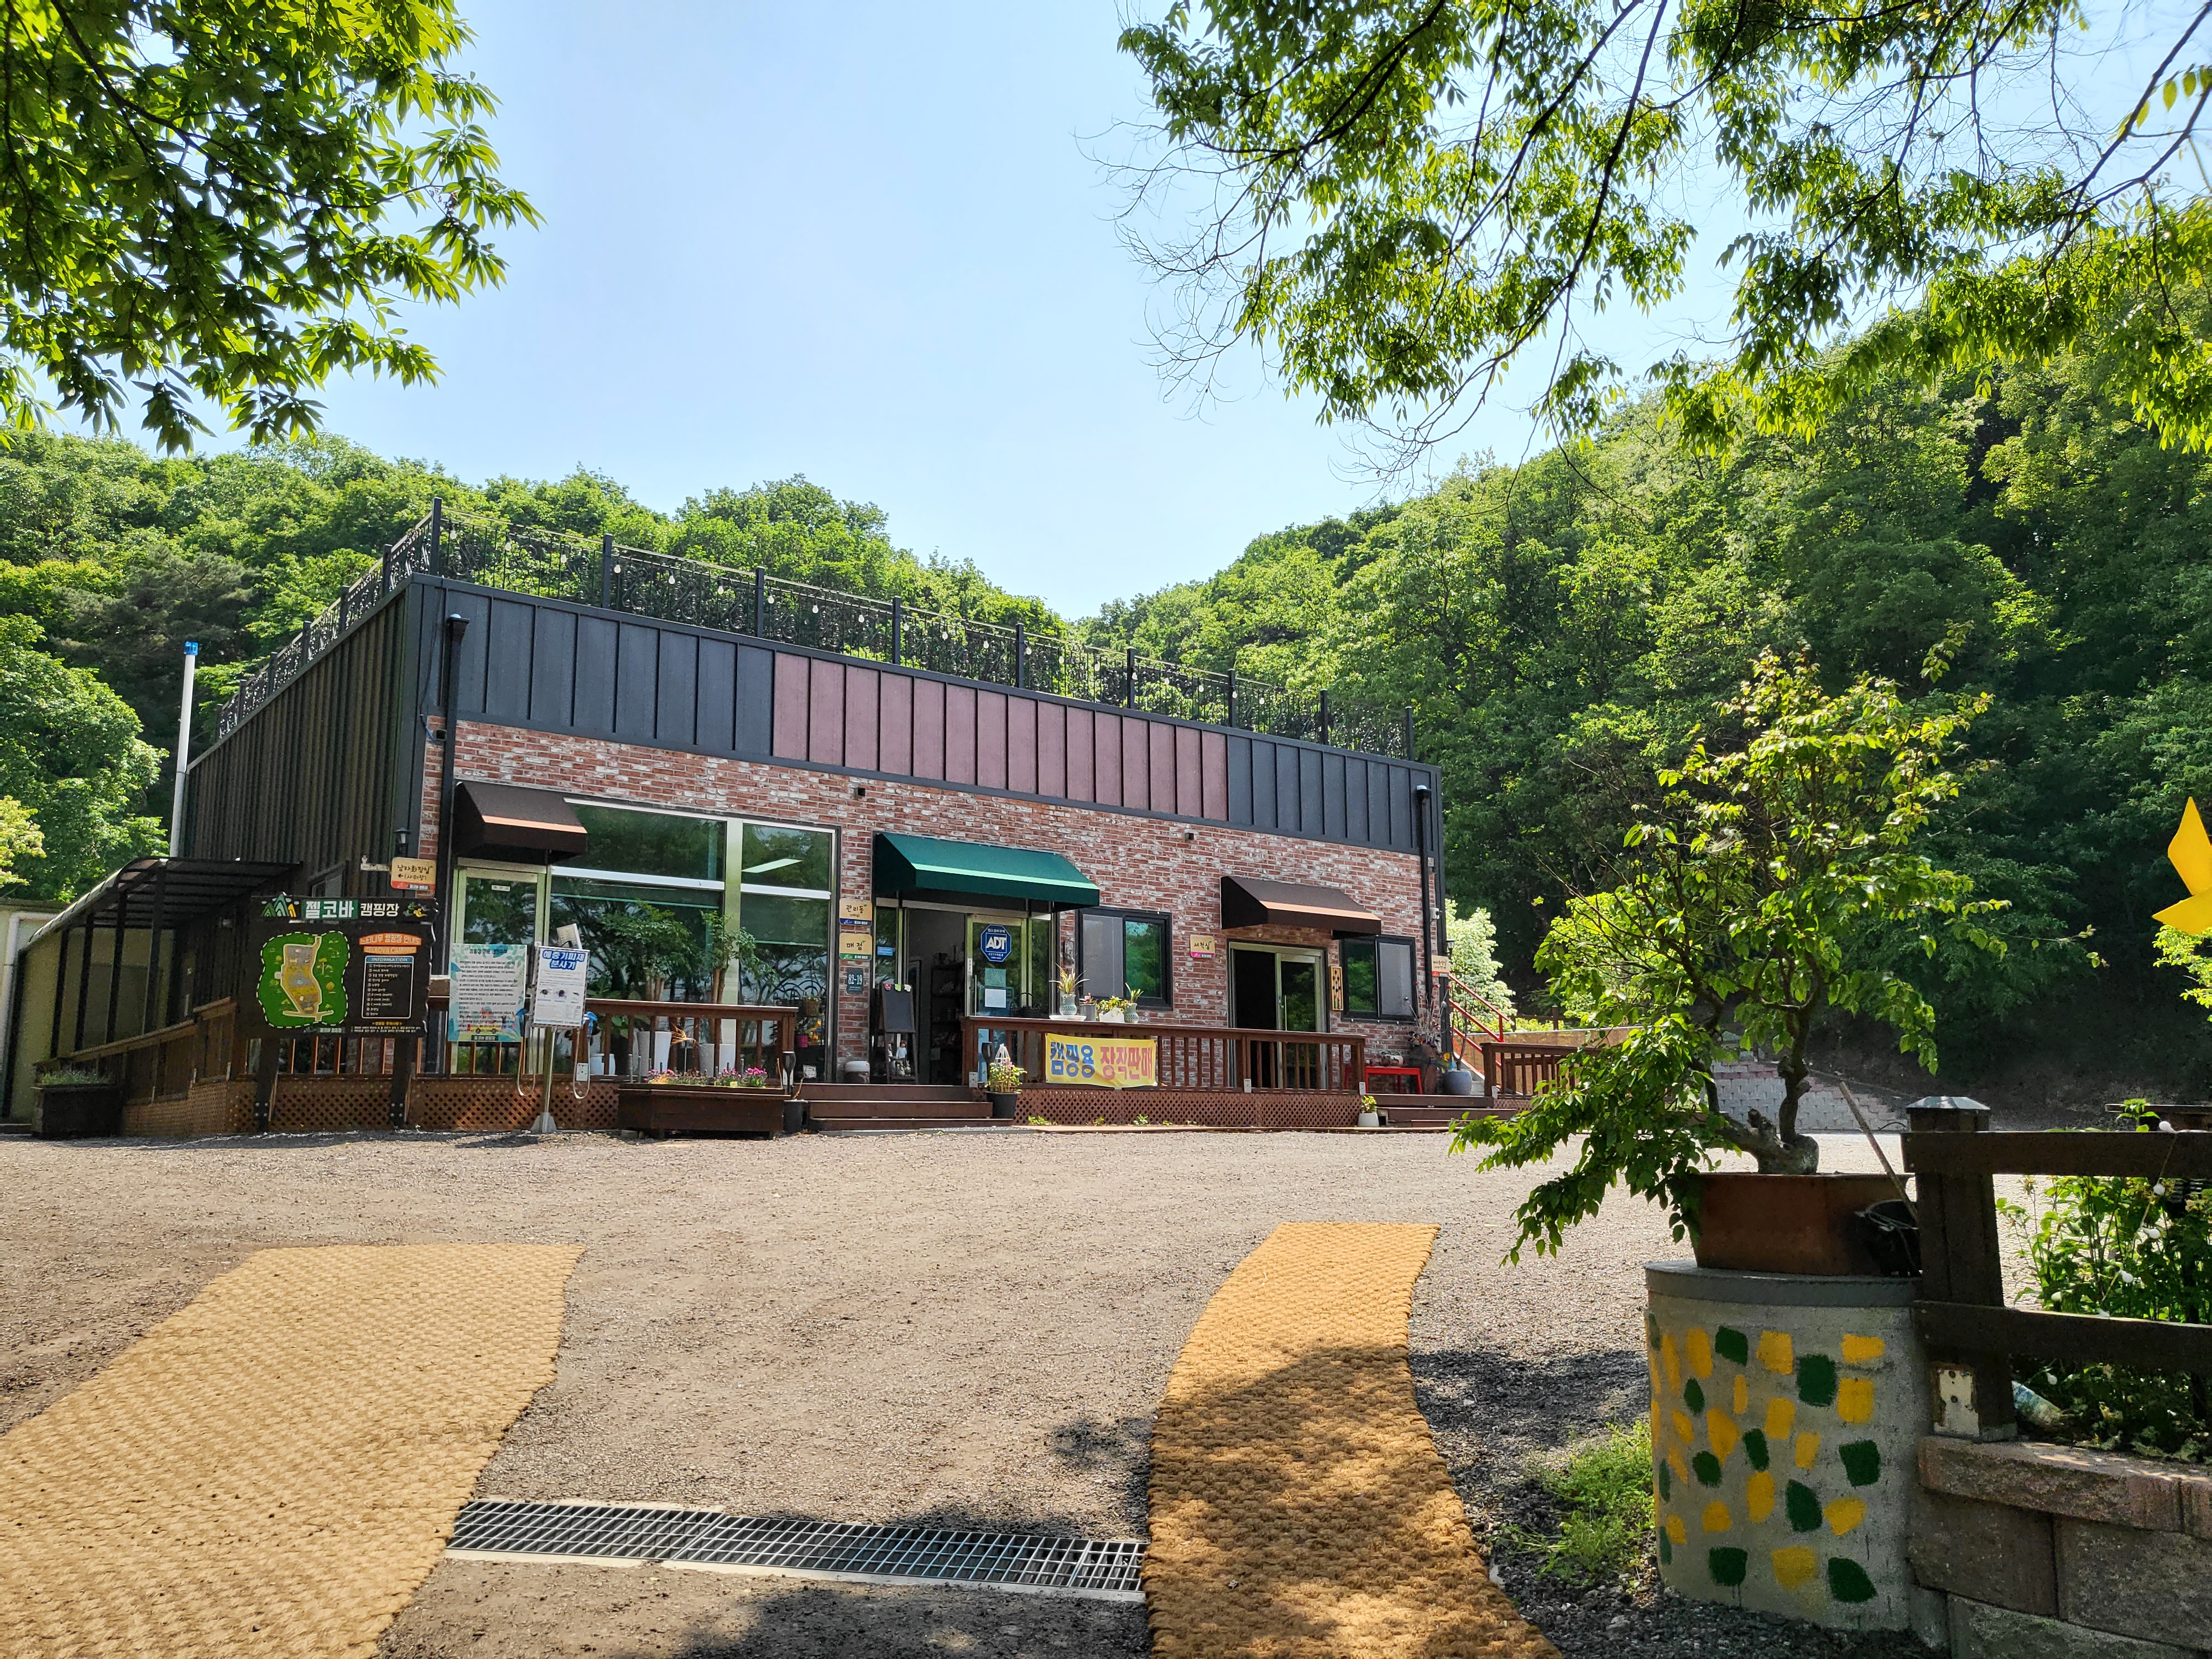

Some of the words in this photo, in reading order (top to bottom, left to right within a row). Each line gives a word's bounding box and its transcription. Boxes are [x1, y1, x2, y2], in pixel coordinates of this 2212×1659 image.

[398, 864, 430, 874] 남자화장실
[305, 900, 354, 919] 젤코바
[360, 902, 400, 917] 캠핑장
[846, 905, 864, 914] 관리동
[986, 936, 1006, 950] ADT
[551, 960, 576, 969] 분사기
[848, 974, 863, 985] 82-19
[1050, 1042, 1095, 1078] 캠핑용
[1100, 1046, 1152, 1080] 장작판매
